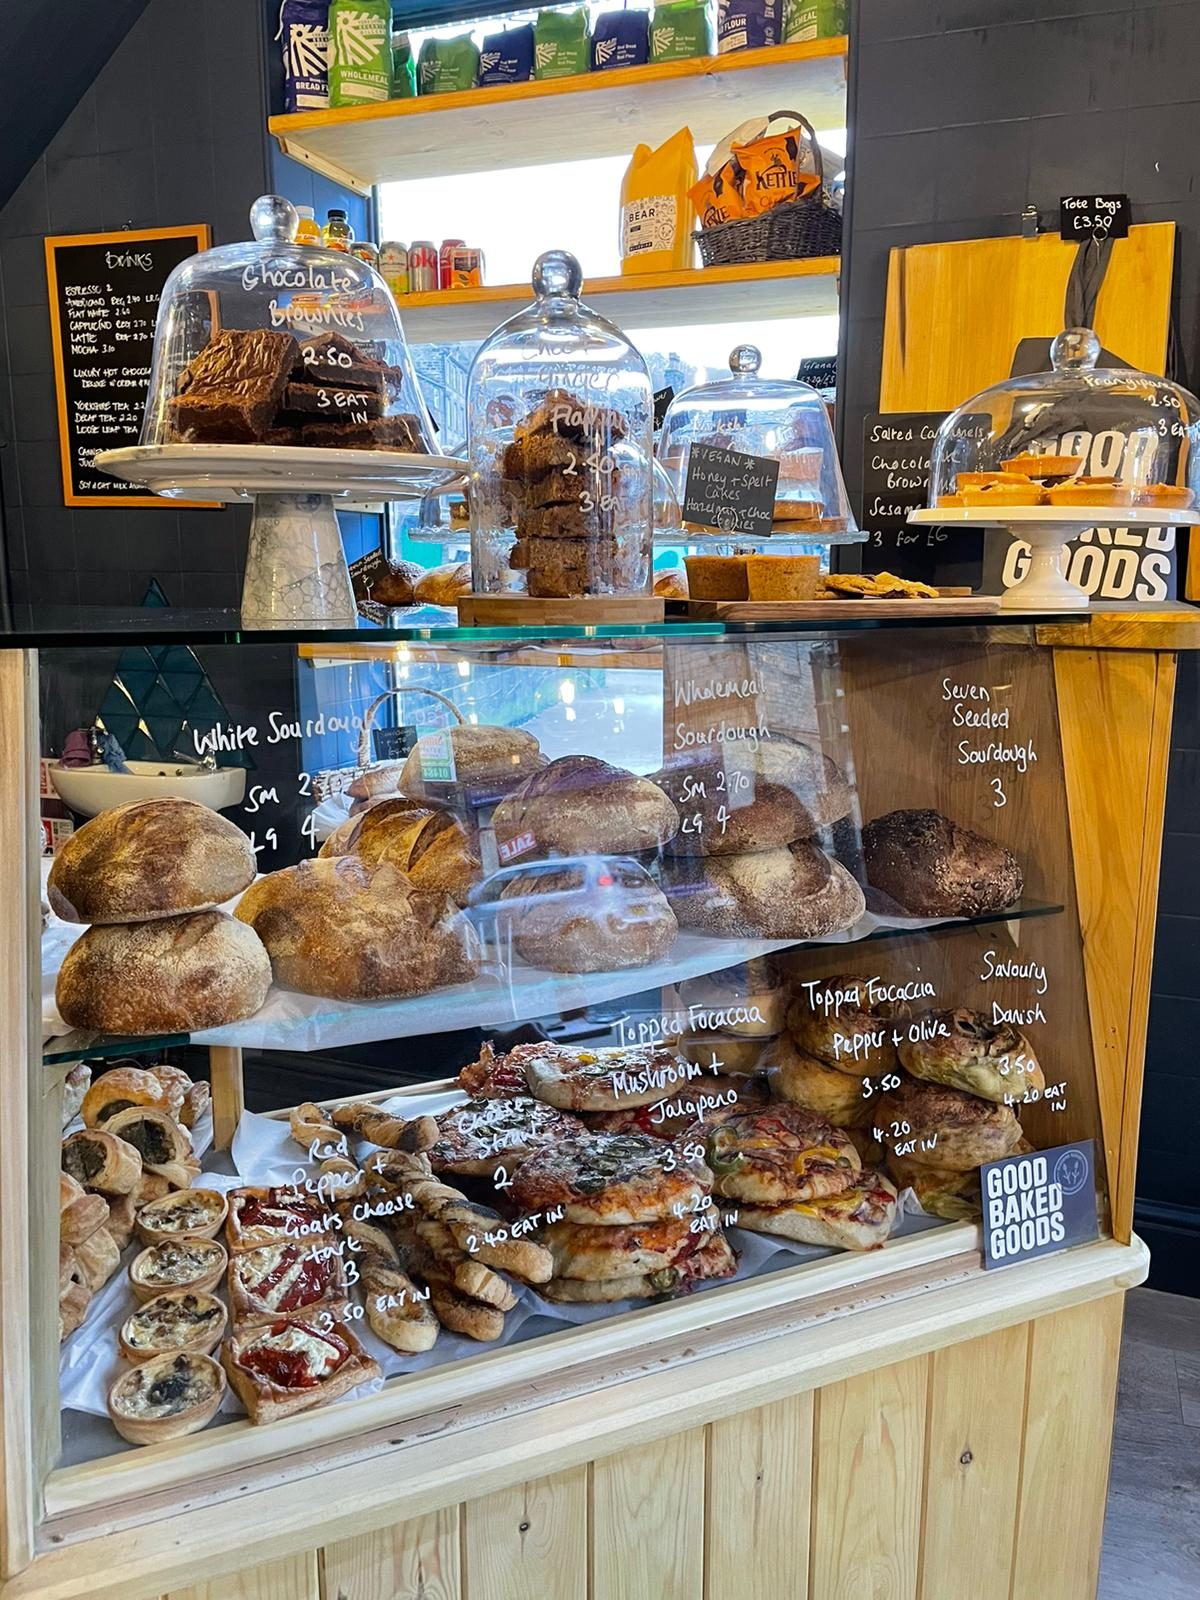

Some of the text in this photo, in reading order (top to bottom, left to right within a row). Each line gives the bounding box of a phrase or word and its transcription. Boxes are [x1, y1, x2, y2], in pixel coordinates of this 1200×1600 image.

[724, 18, 747, 31] FLOUR
[295, 82, 321, 90] BREAD
[340, 70, 389, 85] WHOLEMEAL
[755, 165, 798, 191] KETTLE
[629, 208, 656, 222] BEAR
[1062, 197, 1123, 215] Tote Bags
[1073, 215, 1113, 230] £3.50
[242, 264, 351, 292] Chocolate
[269, 299, 364, 333] Brownies
[71, 344, 99, 355] MOCHA
[301, 346, 353, 369] 2.50
[317, 389, 369, 408] 3 EAT
[1147, 394, 1181, 409] 2.50
[350, 410, 369, 424] IN
[1157, 418, 1168, 437] 3
[870, 425, 913, 442] Salted
[562, 452, 615, 476] 2.50
[691, 467, 727, 490] Honey
[740, 473, 773, 490] Spelt
[579, 491, 595, 513] 3
[704, 484, 741, 501] Cakes
[747, 506, 771, 521] Choc
[873, 525, 948, 547] 3 for £6
[1002, 540, 1172, 602] GODS
[674, 671, 768, 708] Wholemeal
[942, 678, 990, 701] Seven
[952, 703, 1010, 729] Seeded
[193, 722, 260, 756] White
[673, 714, 772, 753] Sourdough
[958, 739, 1038, 773] Sourdough
[716, 771, 750, 794] 2.70
[990, 778, 1007, 807] 3
[301, 814, 320, 851] 4
[716, 806, 732, 834] 4
[980, 950, 1048, 994] Savoury
[801, 976, 937, 1018] Topped Focaccia
[991, 1001, 1047, 1026] Danish
[610, 1003, 767, 1055] Topped Focaccia
[832, 1019, 951, 1061] Pepper + Olive
[612, 1052, 725, 1100] Mushroom +
[999, 1054, 1036, 1076] 3.50
[862, 1073, 901, 1099] 3.50
[1003, 1082, 1068, 1108] 4.20 EAT
[648, 1089, 738, 1125] Jalapeno
[1050, 1097, 1068, 1112] IN
[873, 1120, 911, 1143] 4.20
[308, 1135, 350, 1163] Red
[894, 1134, 938, 1157] EAT IN
[290, 1167, 366, 1205] Pepper
[493, 1166, 515, 1191] 2
[987, 1156, 1048, 1199] GOOD
[352, 1193, 416, 1222] Cheese
[988, 1182, 1064, 1229] BAKED
[466, 1205, 567, 1254] 2.40 EAT IN
[689, 1209, 740, 1234] EAT IN
[990, 1211, 1066, 1260] GOODS
[342, 1260, 361, 1288] 3
[375, 1292, 407, 1313] EAT
[412, 1286, 432, 1303] IN
